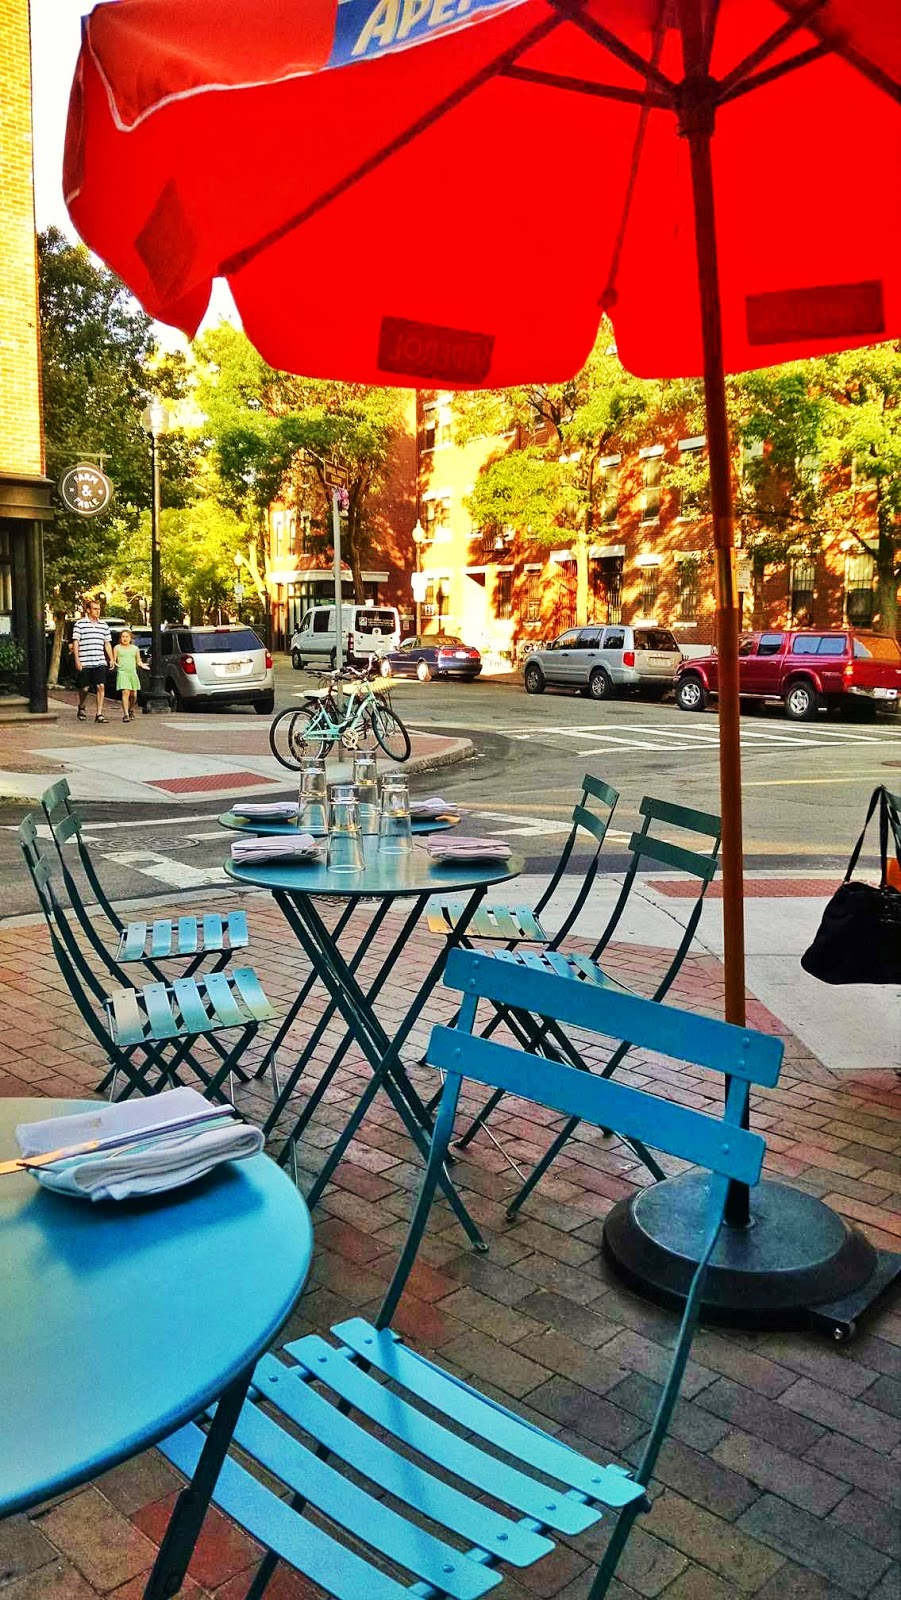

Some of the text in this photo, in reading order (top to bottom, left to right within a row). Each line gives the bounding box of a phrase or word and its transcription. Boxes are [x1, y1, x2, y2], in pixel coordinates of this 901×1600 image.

[73, 473, 99, 485] FARM
[82, 484, 92, 497] &
[74, 497, 99, 509] FABLE
